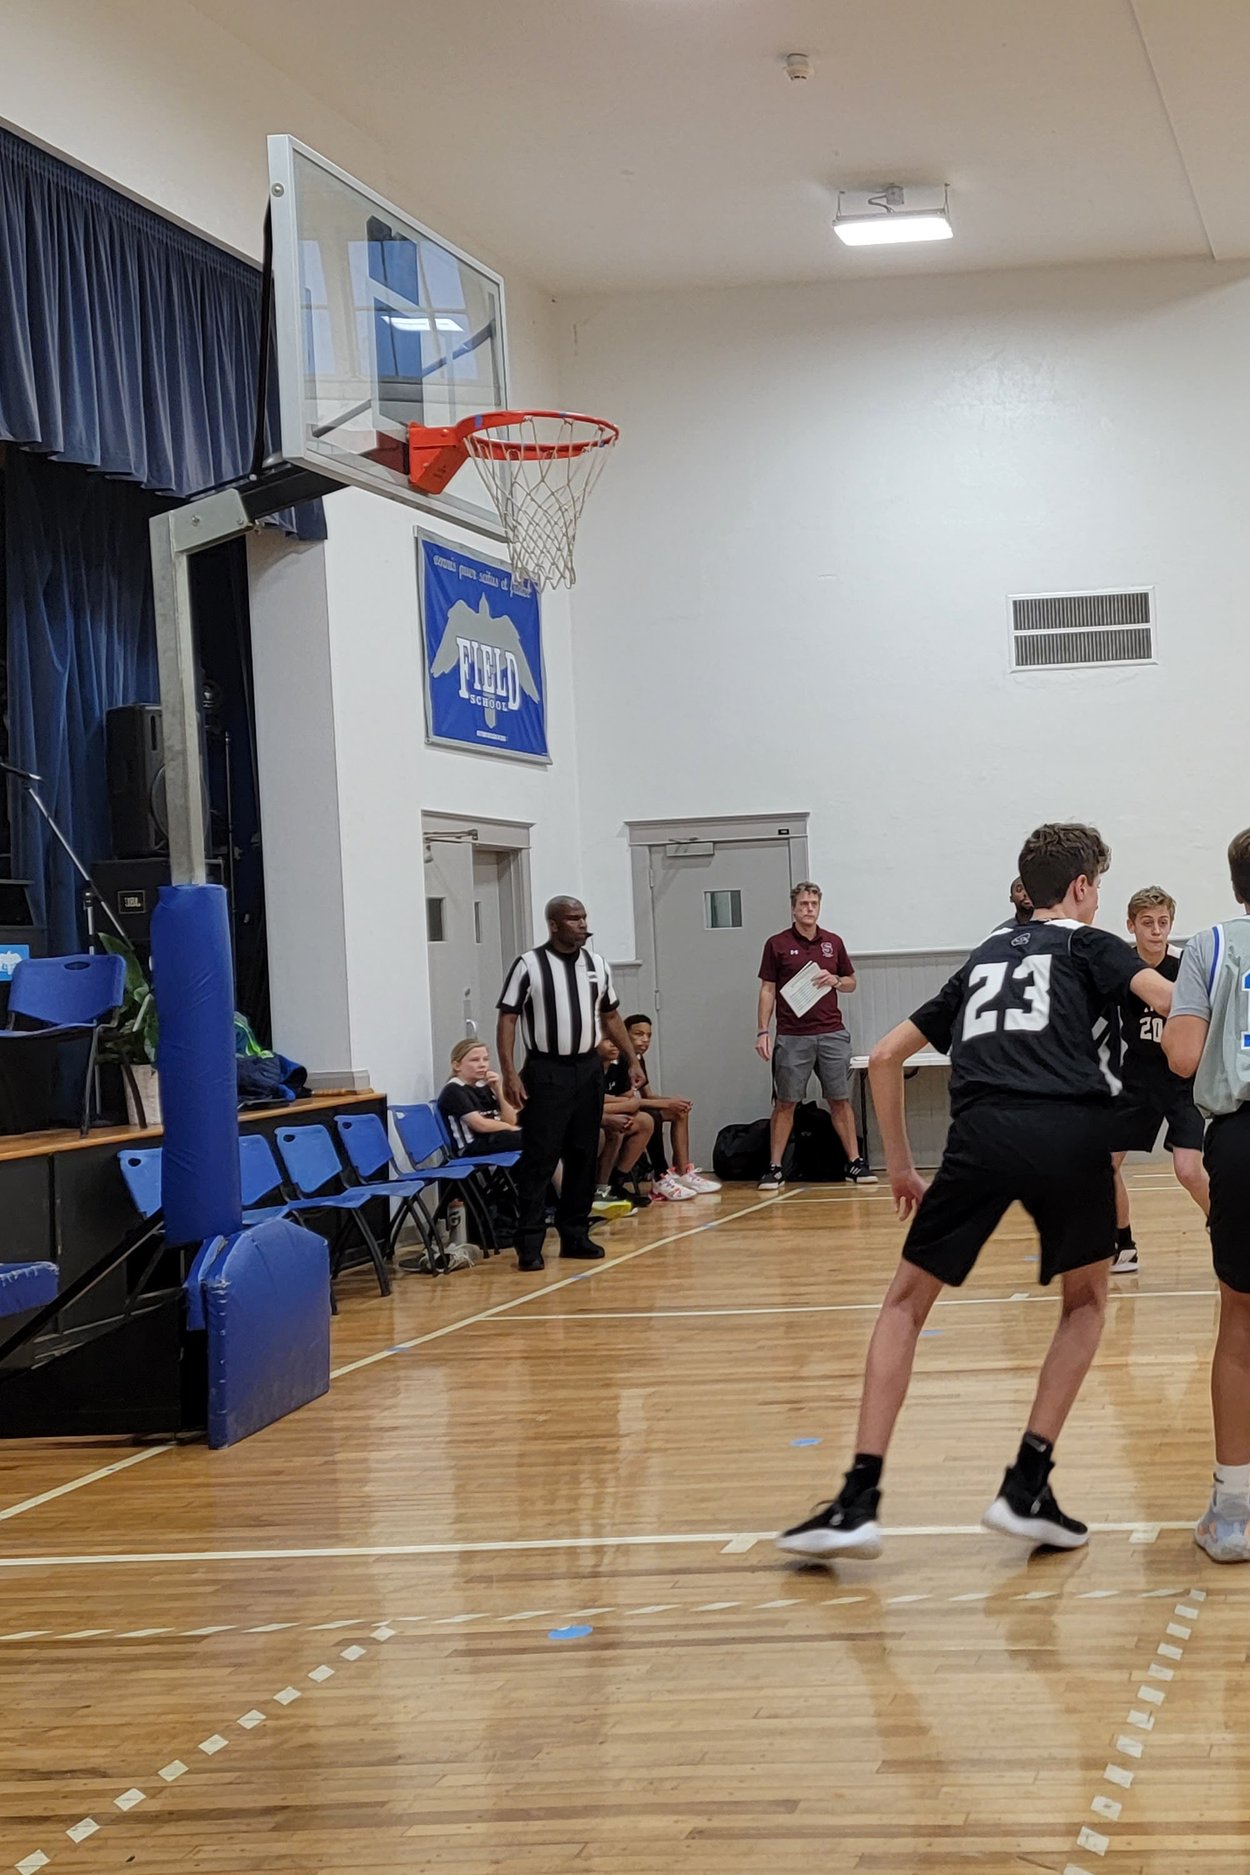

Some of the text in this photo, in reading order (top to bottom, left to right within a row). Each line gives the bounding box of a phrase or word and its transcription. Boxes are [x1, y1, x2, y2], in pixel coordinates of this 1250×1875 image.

[456, 637, 521, 711] FIELD
[470, 694, 508, 711] SCHOOL
[961, 953, 1052, 1042] 23
[1139, 1016, 1164, 1043] 20
